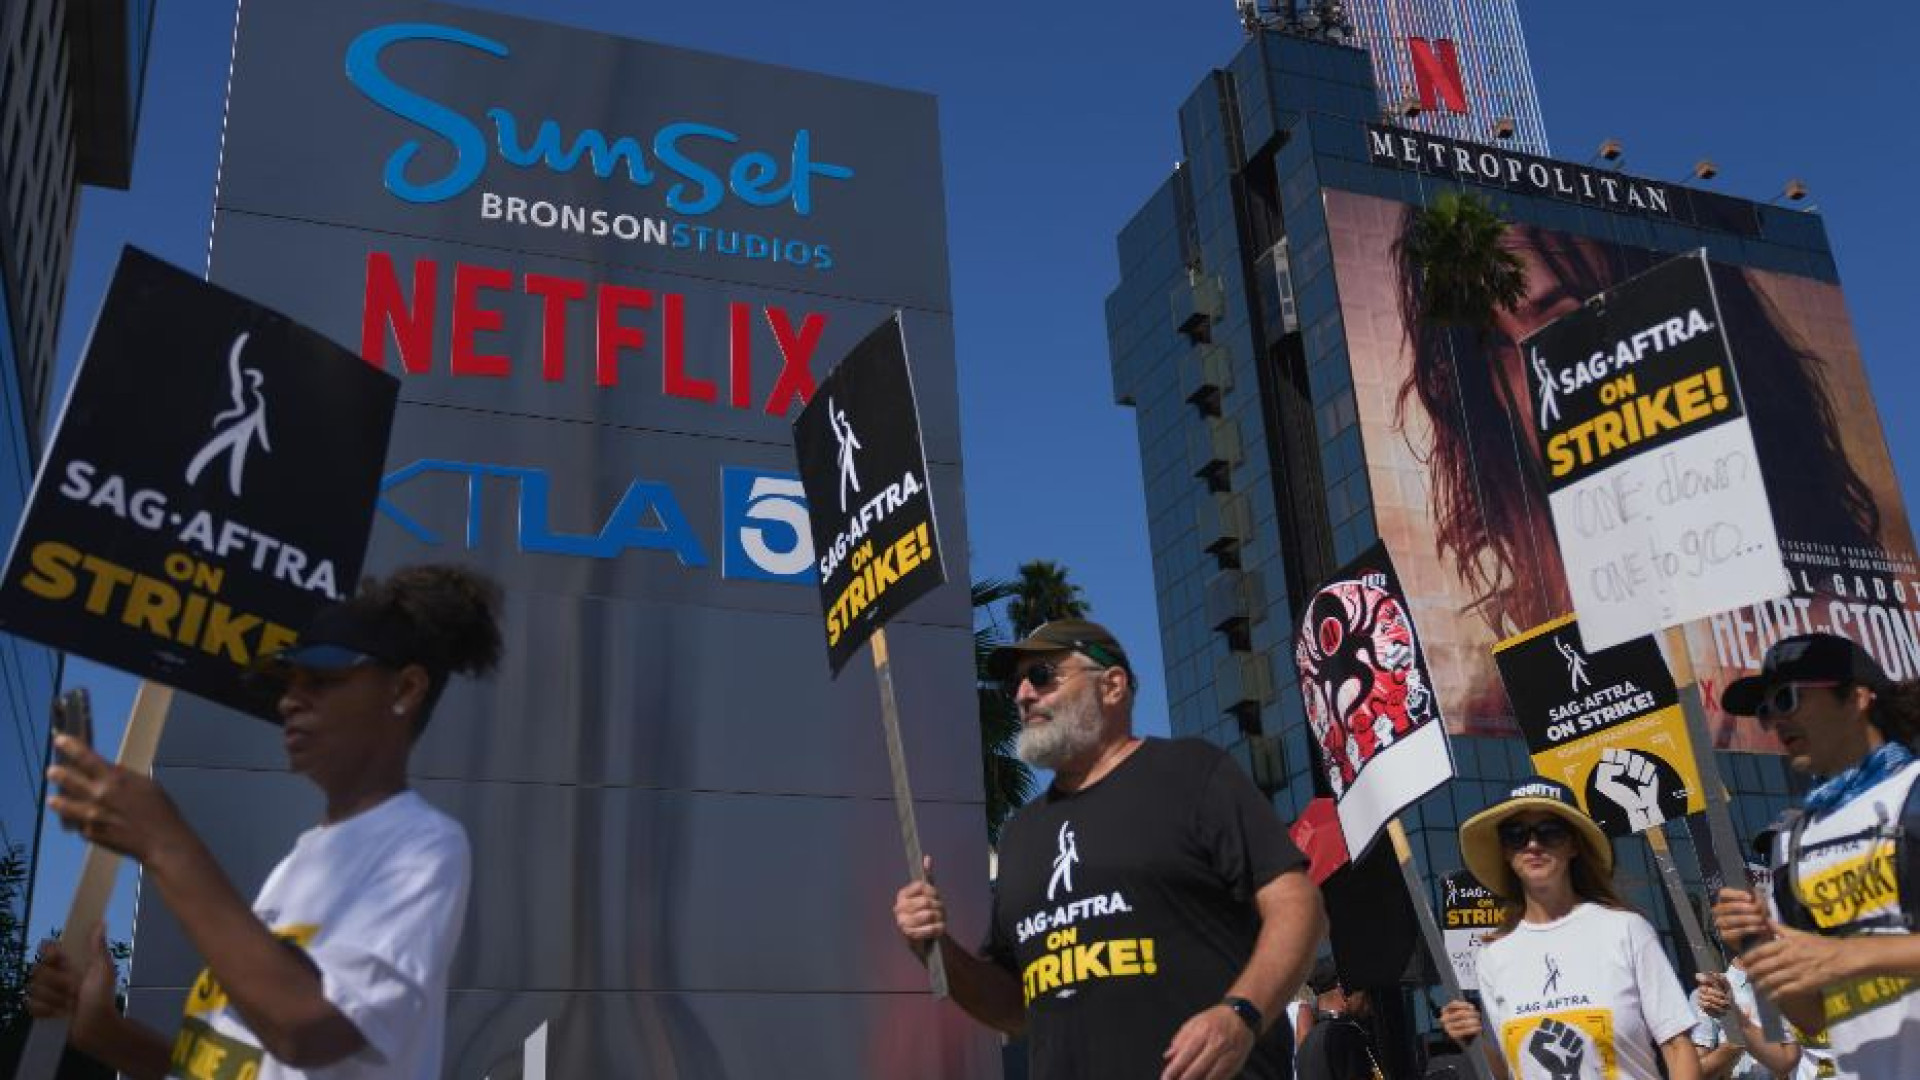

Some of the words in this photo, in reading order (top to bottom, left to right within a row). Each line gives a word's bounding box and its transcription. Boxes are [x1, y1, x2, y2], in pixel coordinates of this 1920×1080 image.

[1371, 130, 1669, 214] METROPOLITAN
[361, 251, 828, 418] NETFLIX
[1547, 365, 1730, 478] STRIKE!
[1600, 372, 1637, 406] ON
[1572, 470, 1644, 539] ONE
[1657, 451, 1748, 505] down
[163, 552, 226, 596] ON
[826, 521, 933, 648] STRIKE!
[851, 539, 874, 571] ON
[1547, 722, 1577, 741] ON
[1579, 691, 1656, 732] STRIKE!
[1046, 926, 1078, 949] ON
